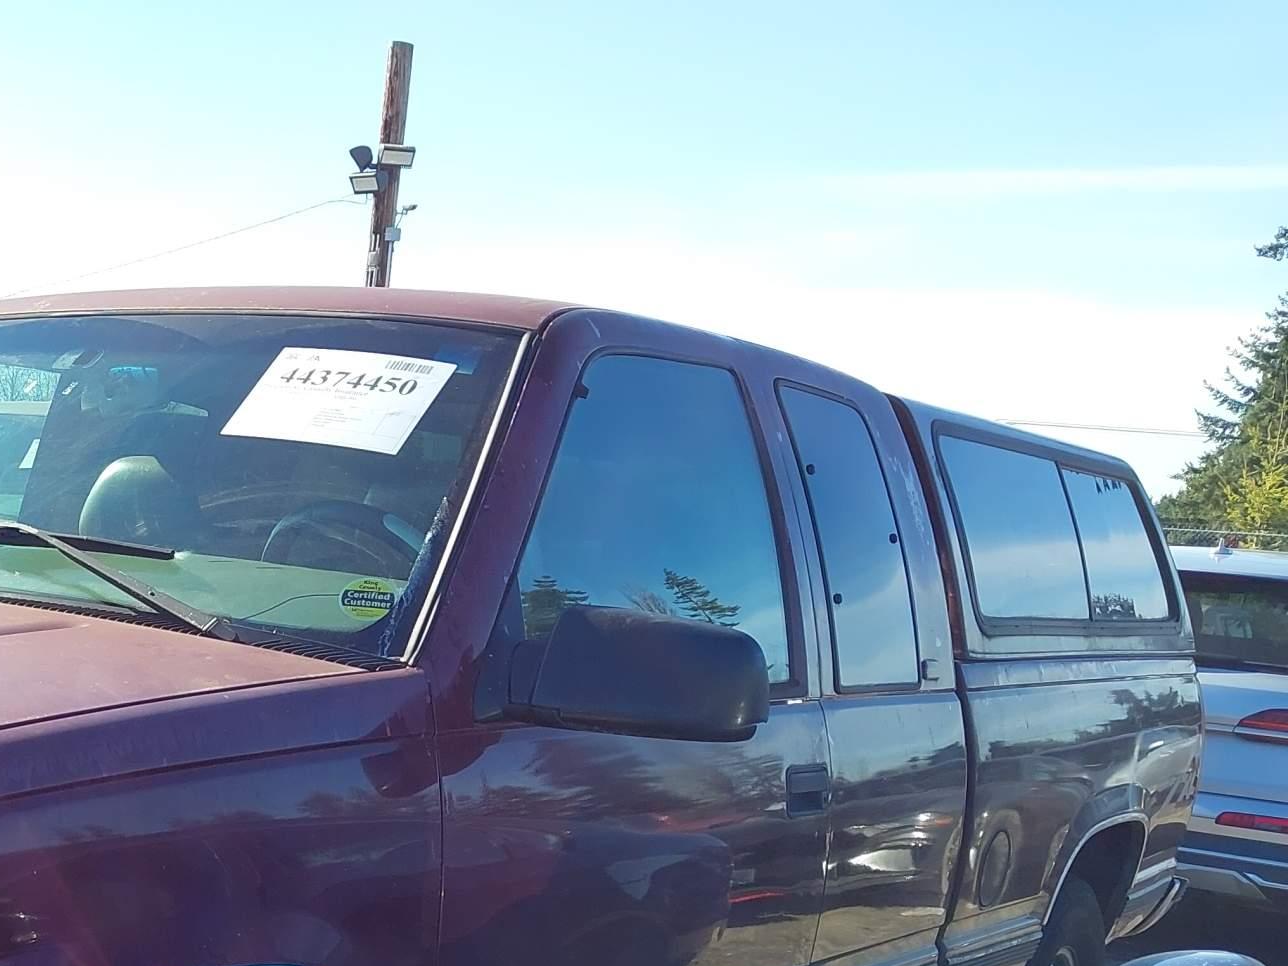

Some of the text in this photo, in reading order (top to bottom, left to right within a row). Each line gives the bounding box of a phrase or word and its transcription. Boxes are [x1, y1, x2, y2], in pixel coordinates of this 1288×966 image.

[280, 367, 418, 396] 44374450
[347, 590, 391, 600] Certified
[344, 598, 392, 608] Customer
